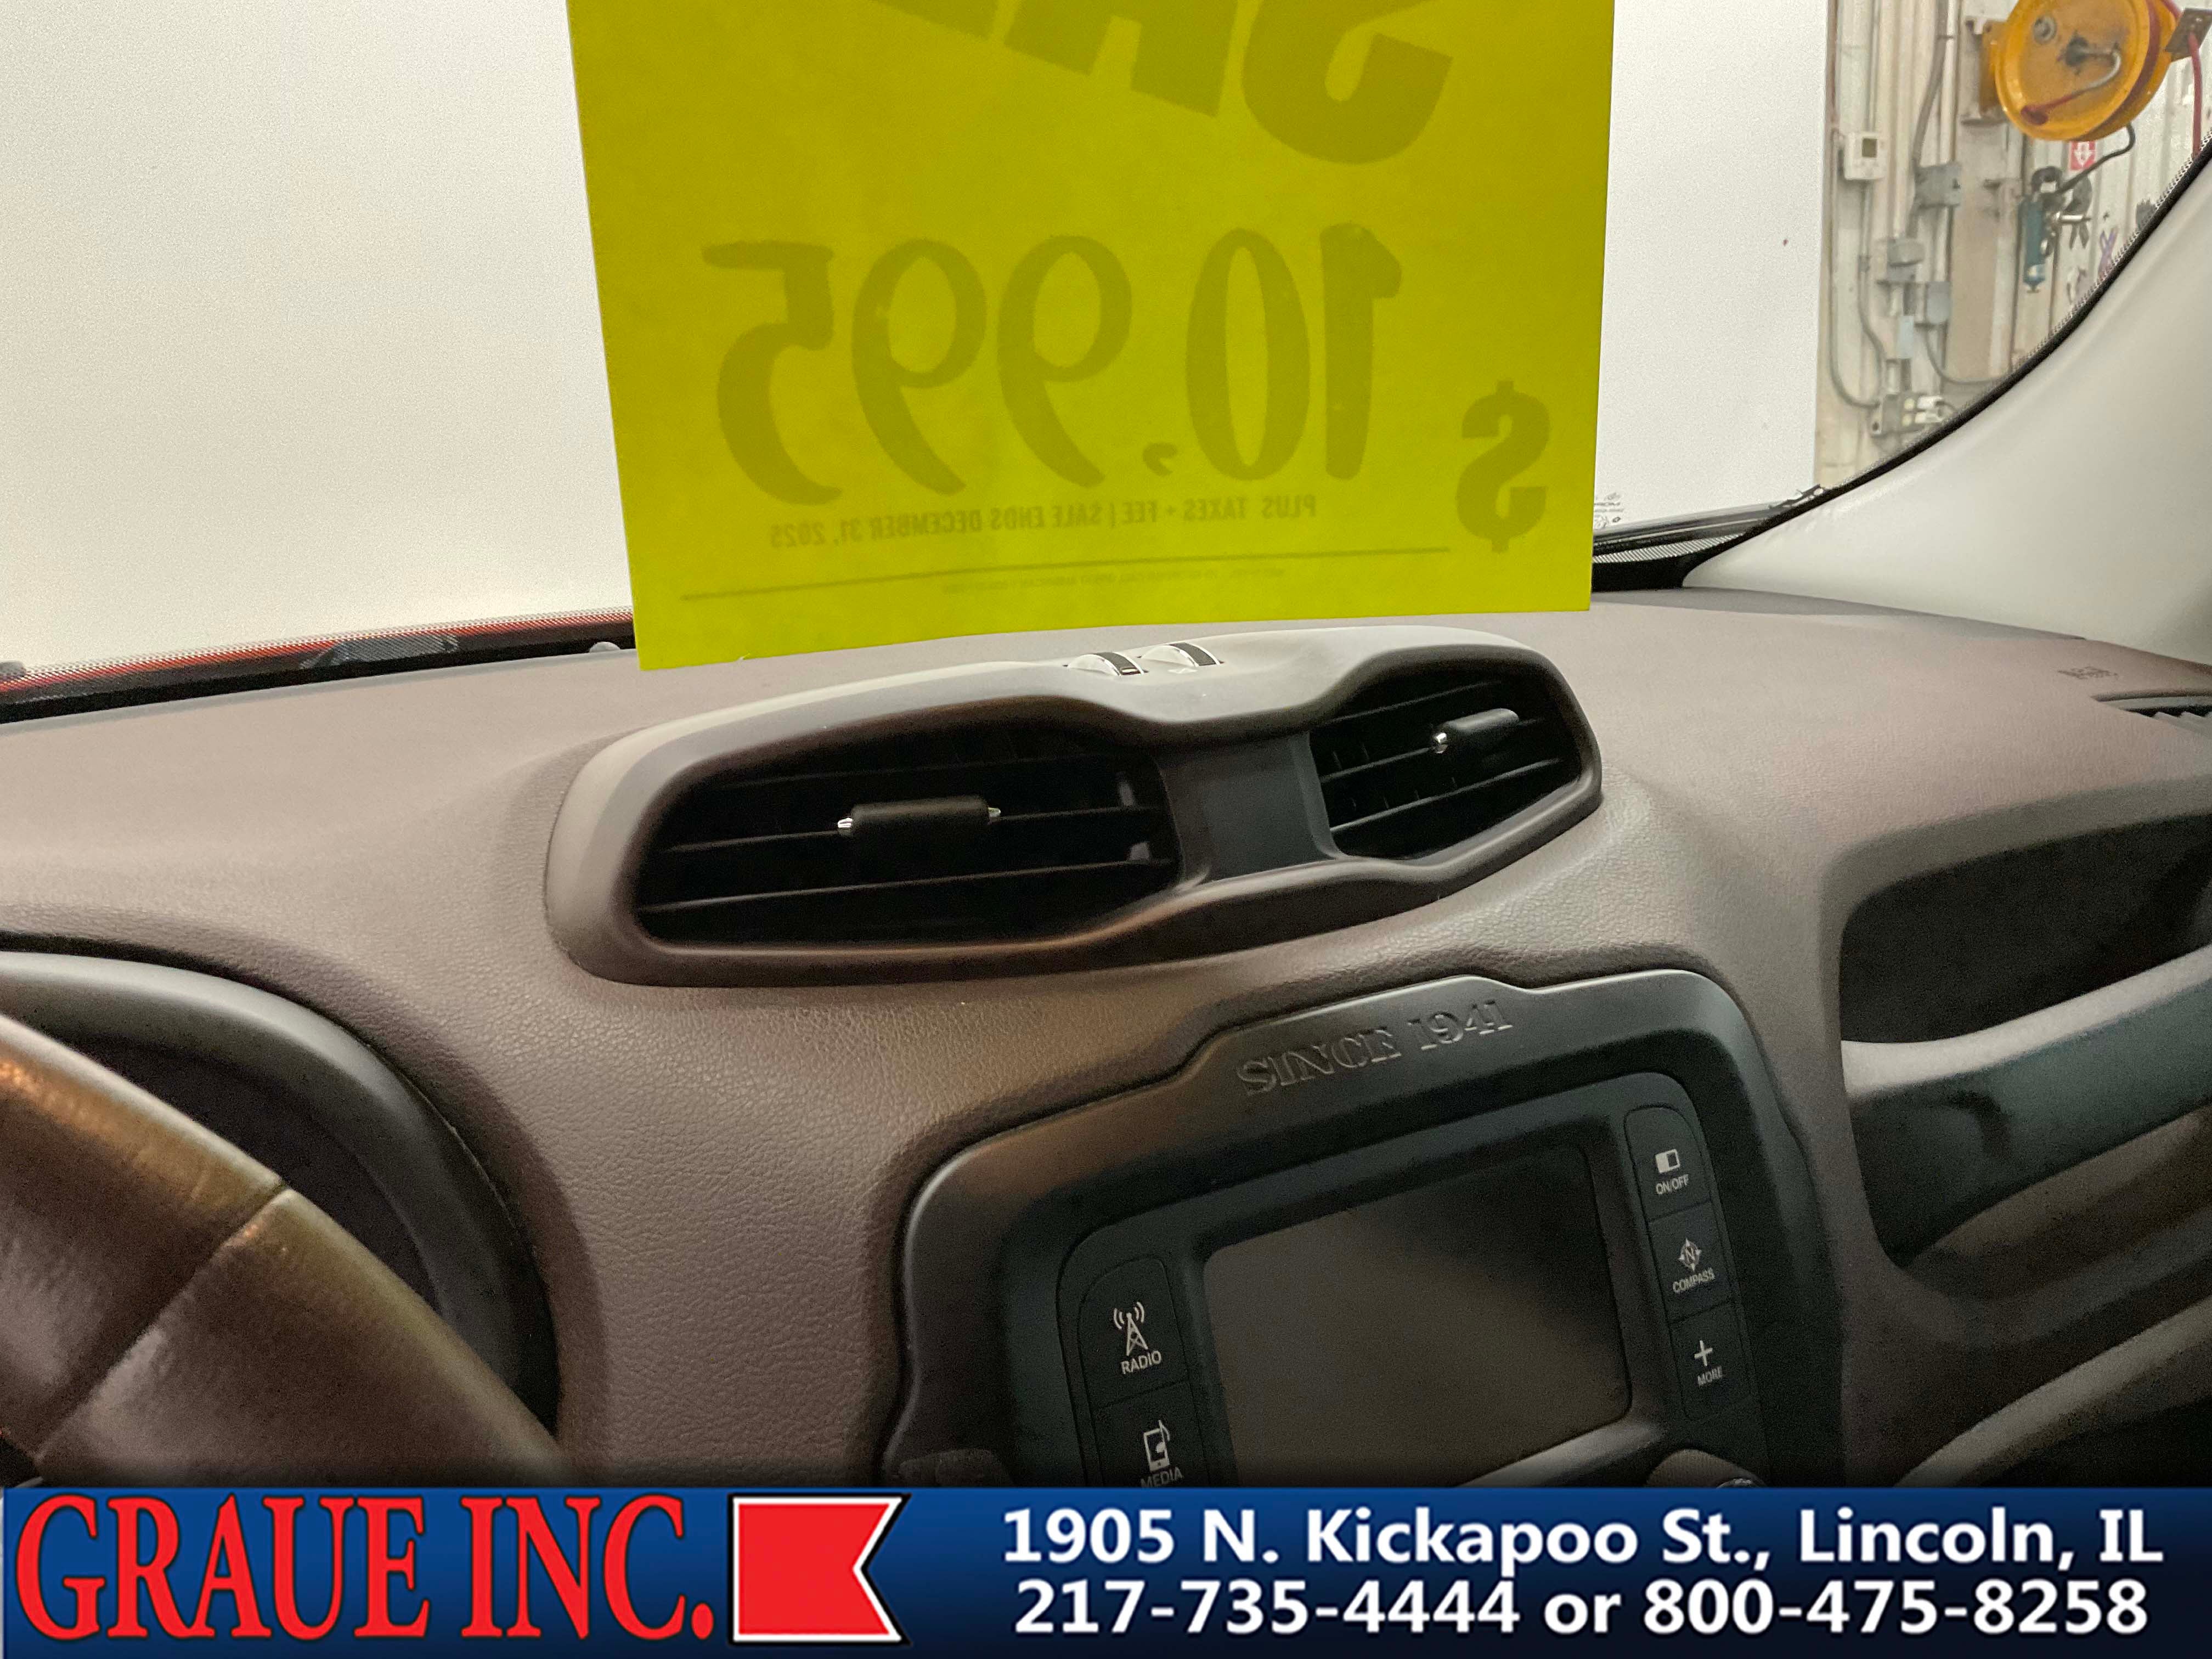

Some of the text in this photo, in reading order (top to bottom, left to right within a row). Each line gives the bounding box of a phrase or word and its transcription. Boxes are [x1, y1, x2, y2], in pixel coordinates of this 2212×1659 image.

[1236, 999, 1514, 1096] SINCE 1941
[1655, 1173, 1690, 1195] ON/OFF
[1672, 1267, 1716, 1294] COMPASS
[1121, 1350, 1163, 1374] RADIO
[1697, 1365, 1724, 1387] MORE
[1141, 1466, 1184, 1488] MEDIA
